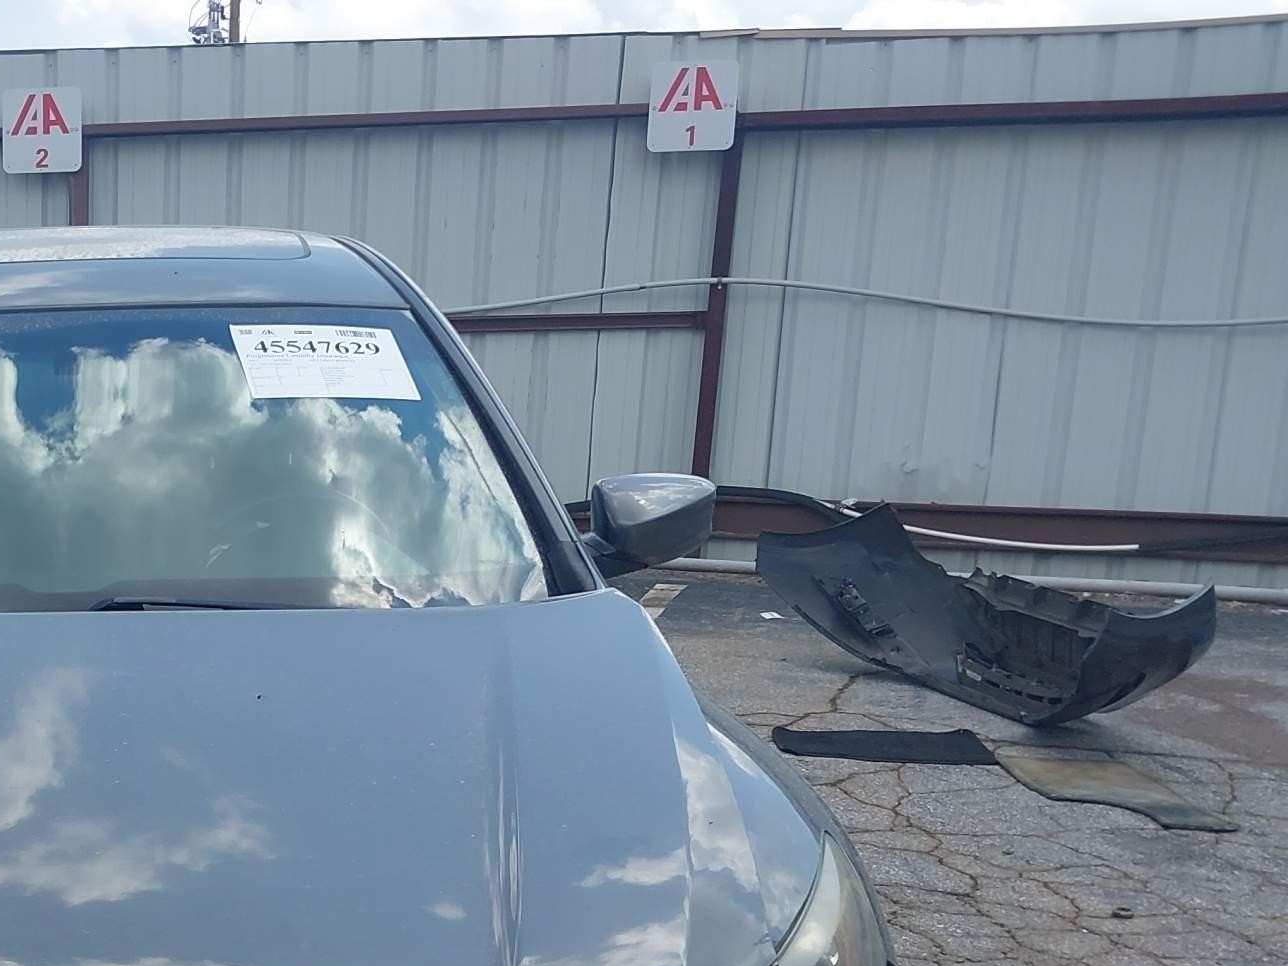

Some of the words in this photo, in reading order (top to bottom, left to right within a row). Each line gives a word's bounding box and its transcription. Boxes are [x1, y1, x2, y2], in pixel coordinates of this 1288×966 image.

[685, 125, 695, 146] 1
[35, 148, 49, 168] 2
[254, 340, 380, 355] 45547629
